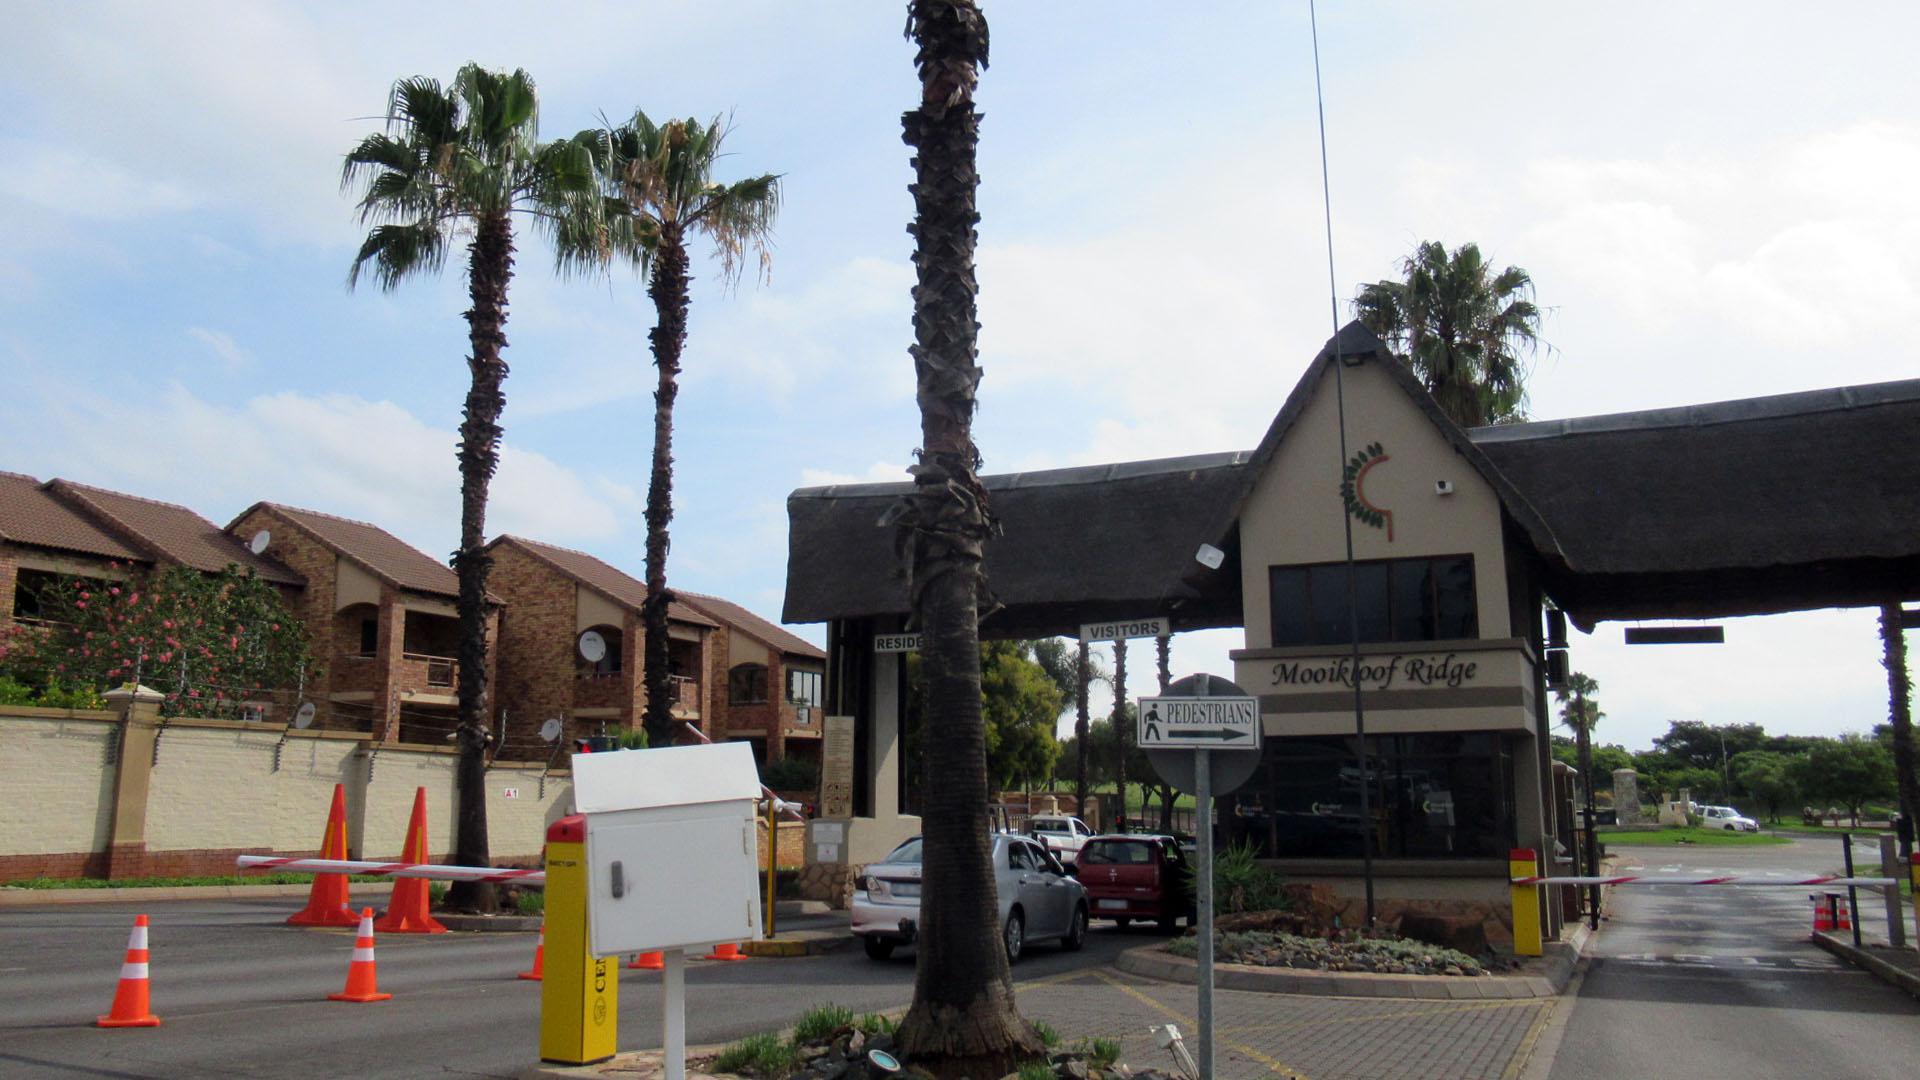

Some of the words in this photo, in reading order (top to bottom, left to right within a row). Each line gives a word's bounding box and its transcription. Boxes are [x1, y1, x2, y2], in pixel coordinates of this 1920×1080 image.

[1090, 622, 1160, 639] VISITORS
[1272, 656, 1402, 689] Mooikloof
[1405, 654, 1476, 687] Ridge
[1167, 703, 1252, 724] PEDESTRIANS
